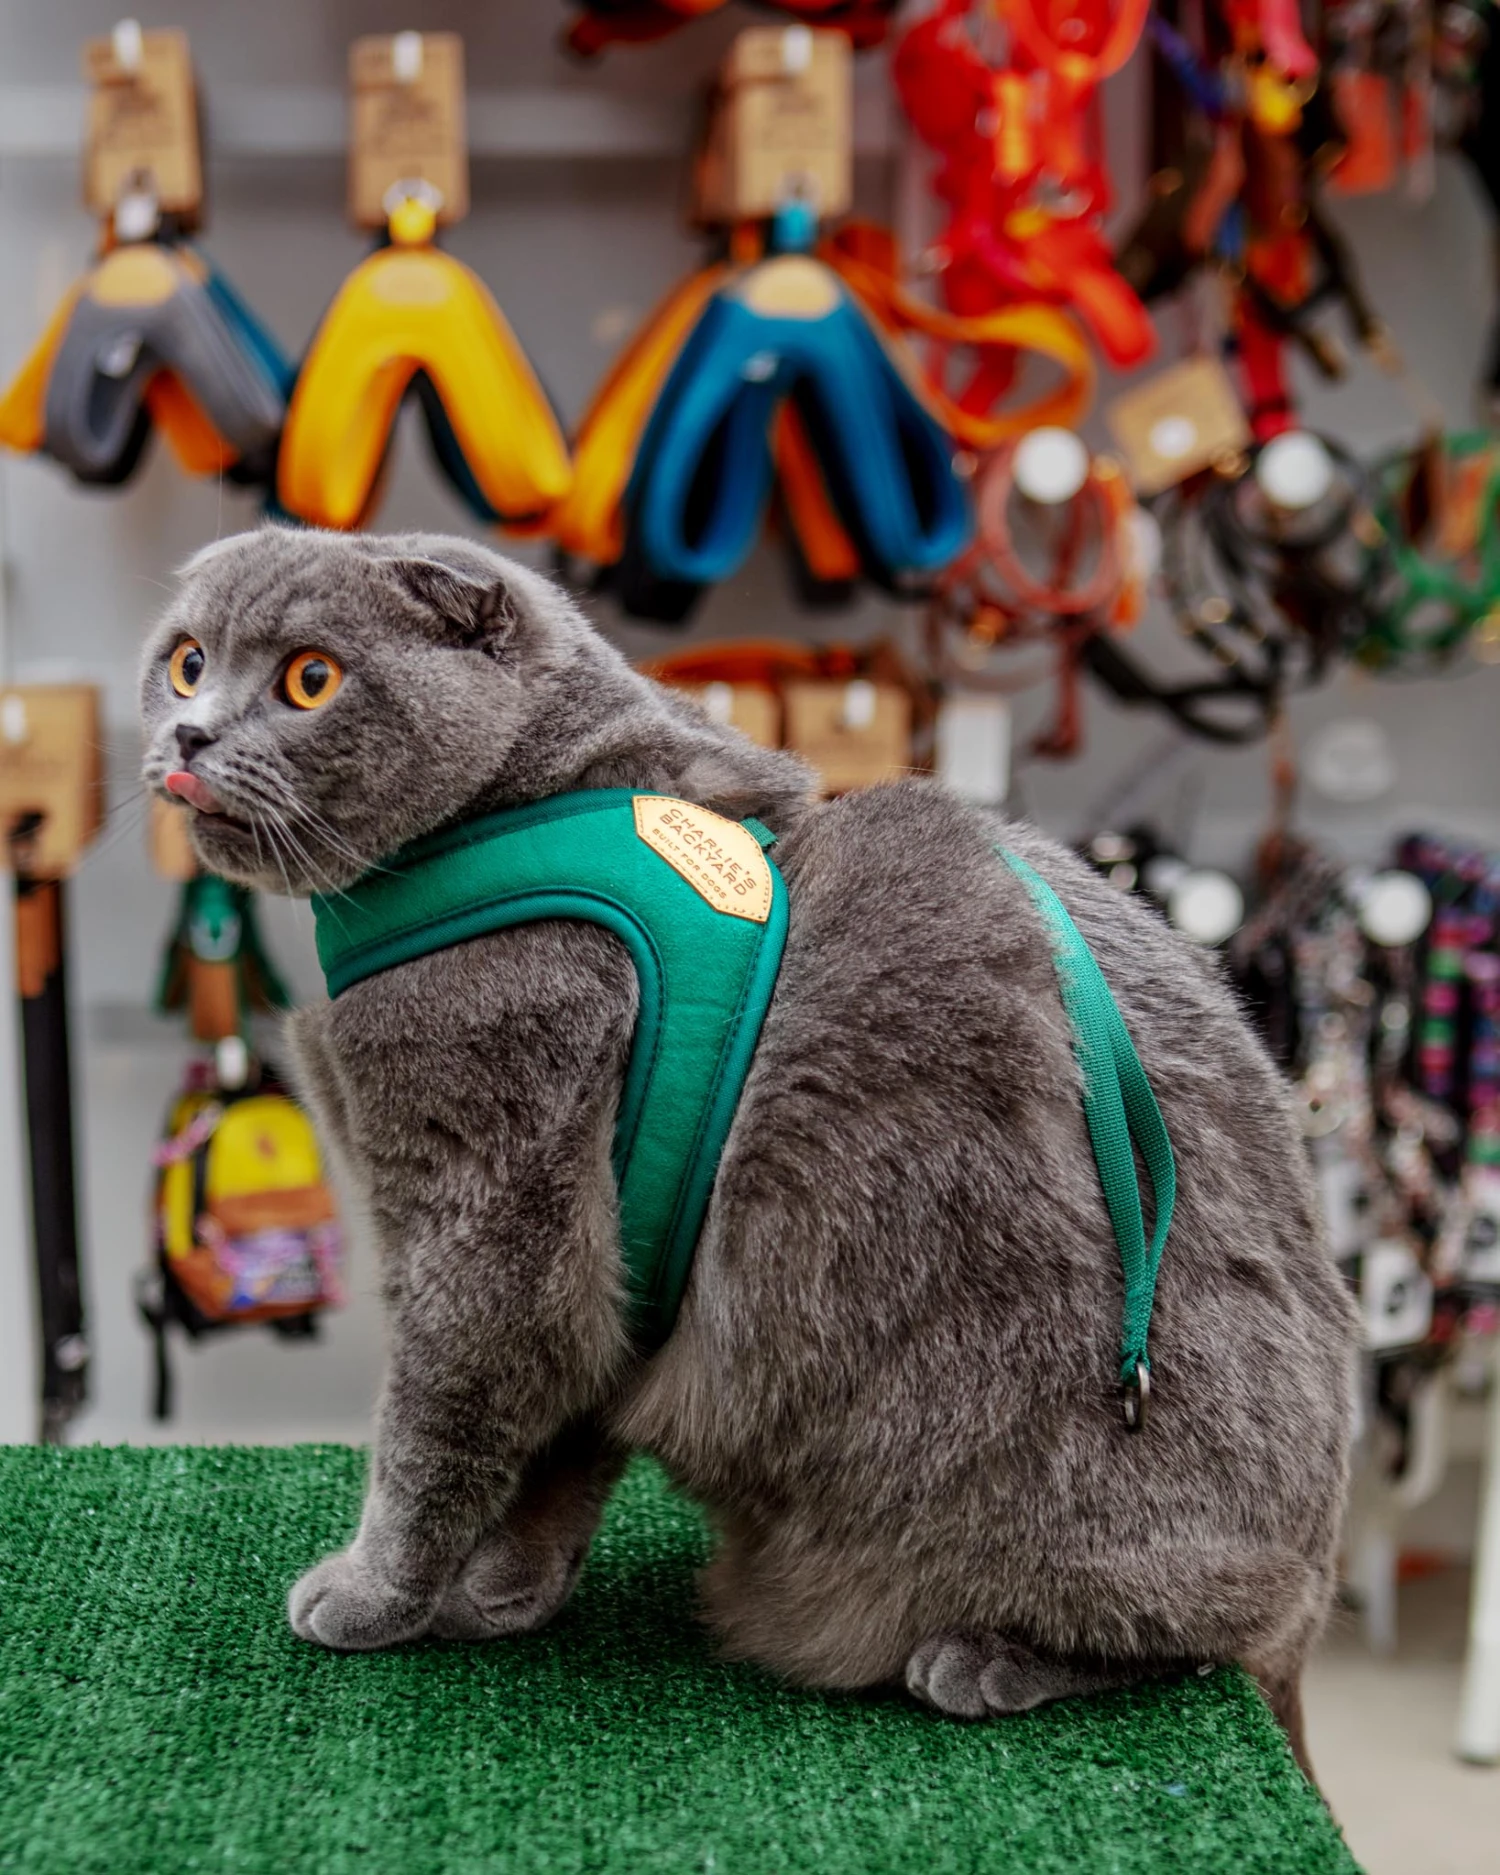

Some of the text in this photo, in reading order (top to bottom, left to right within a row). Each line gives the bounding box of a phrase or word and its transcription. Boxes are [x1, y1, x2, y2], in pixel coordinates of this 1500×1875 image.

[652, 828, 727, 899] BUILT FOR DOGS
[660, 814, 747, 896] BACKYARD
[670, 808, 757, 889] CHARLIE'S
